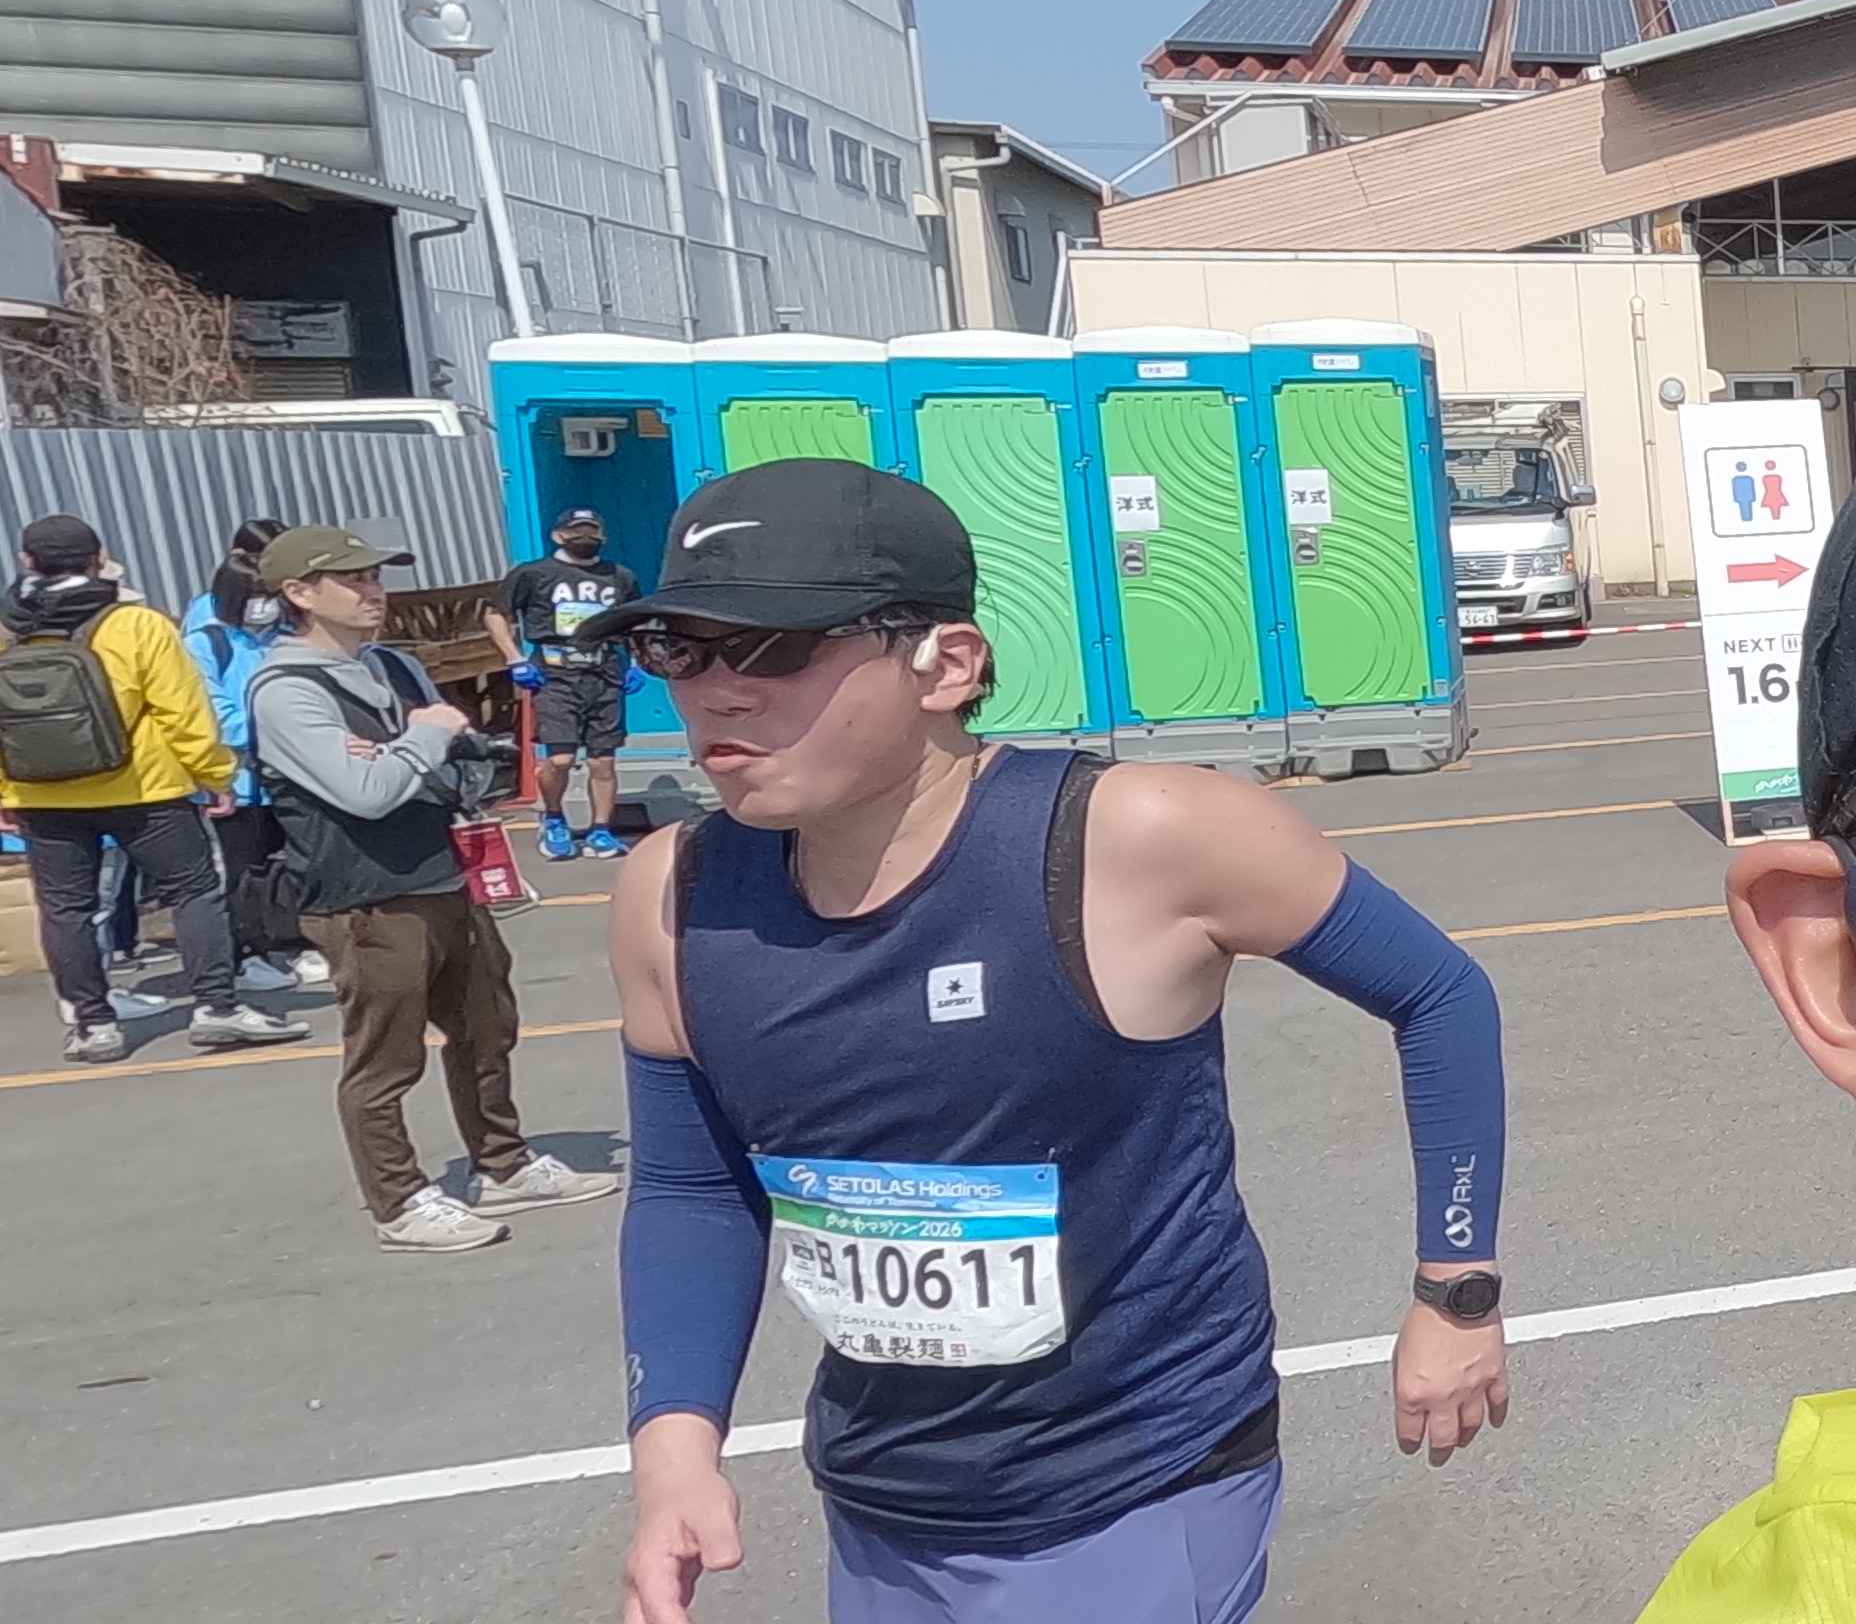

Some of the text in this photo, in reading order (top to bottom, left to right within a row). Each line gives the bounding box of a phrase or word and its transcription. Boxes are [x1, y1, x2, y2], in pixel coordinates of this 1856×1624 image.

[1115, 495, 1154, 513] 洋式
[1290, 488, 1328, 506] 洋式
[1723, 636, 1777, 655] NEXT
[1726, 662, 1791, 705] 1.6
[825, 1175, 1003, 1200] SETOLAS Holdings
